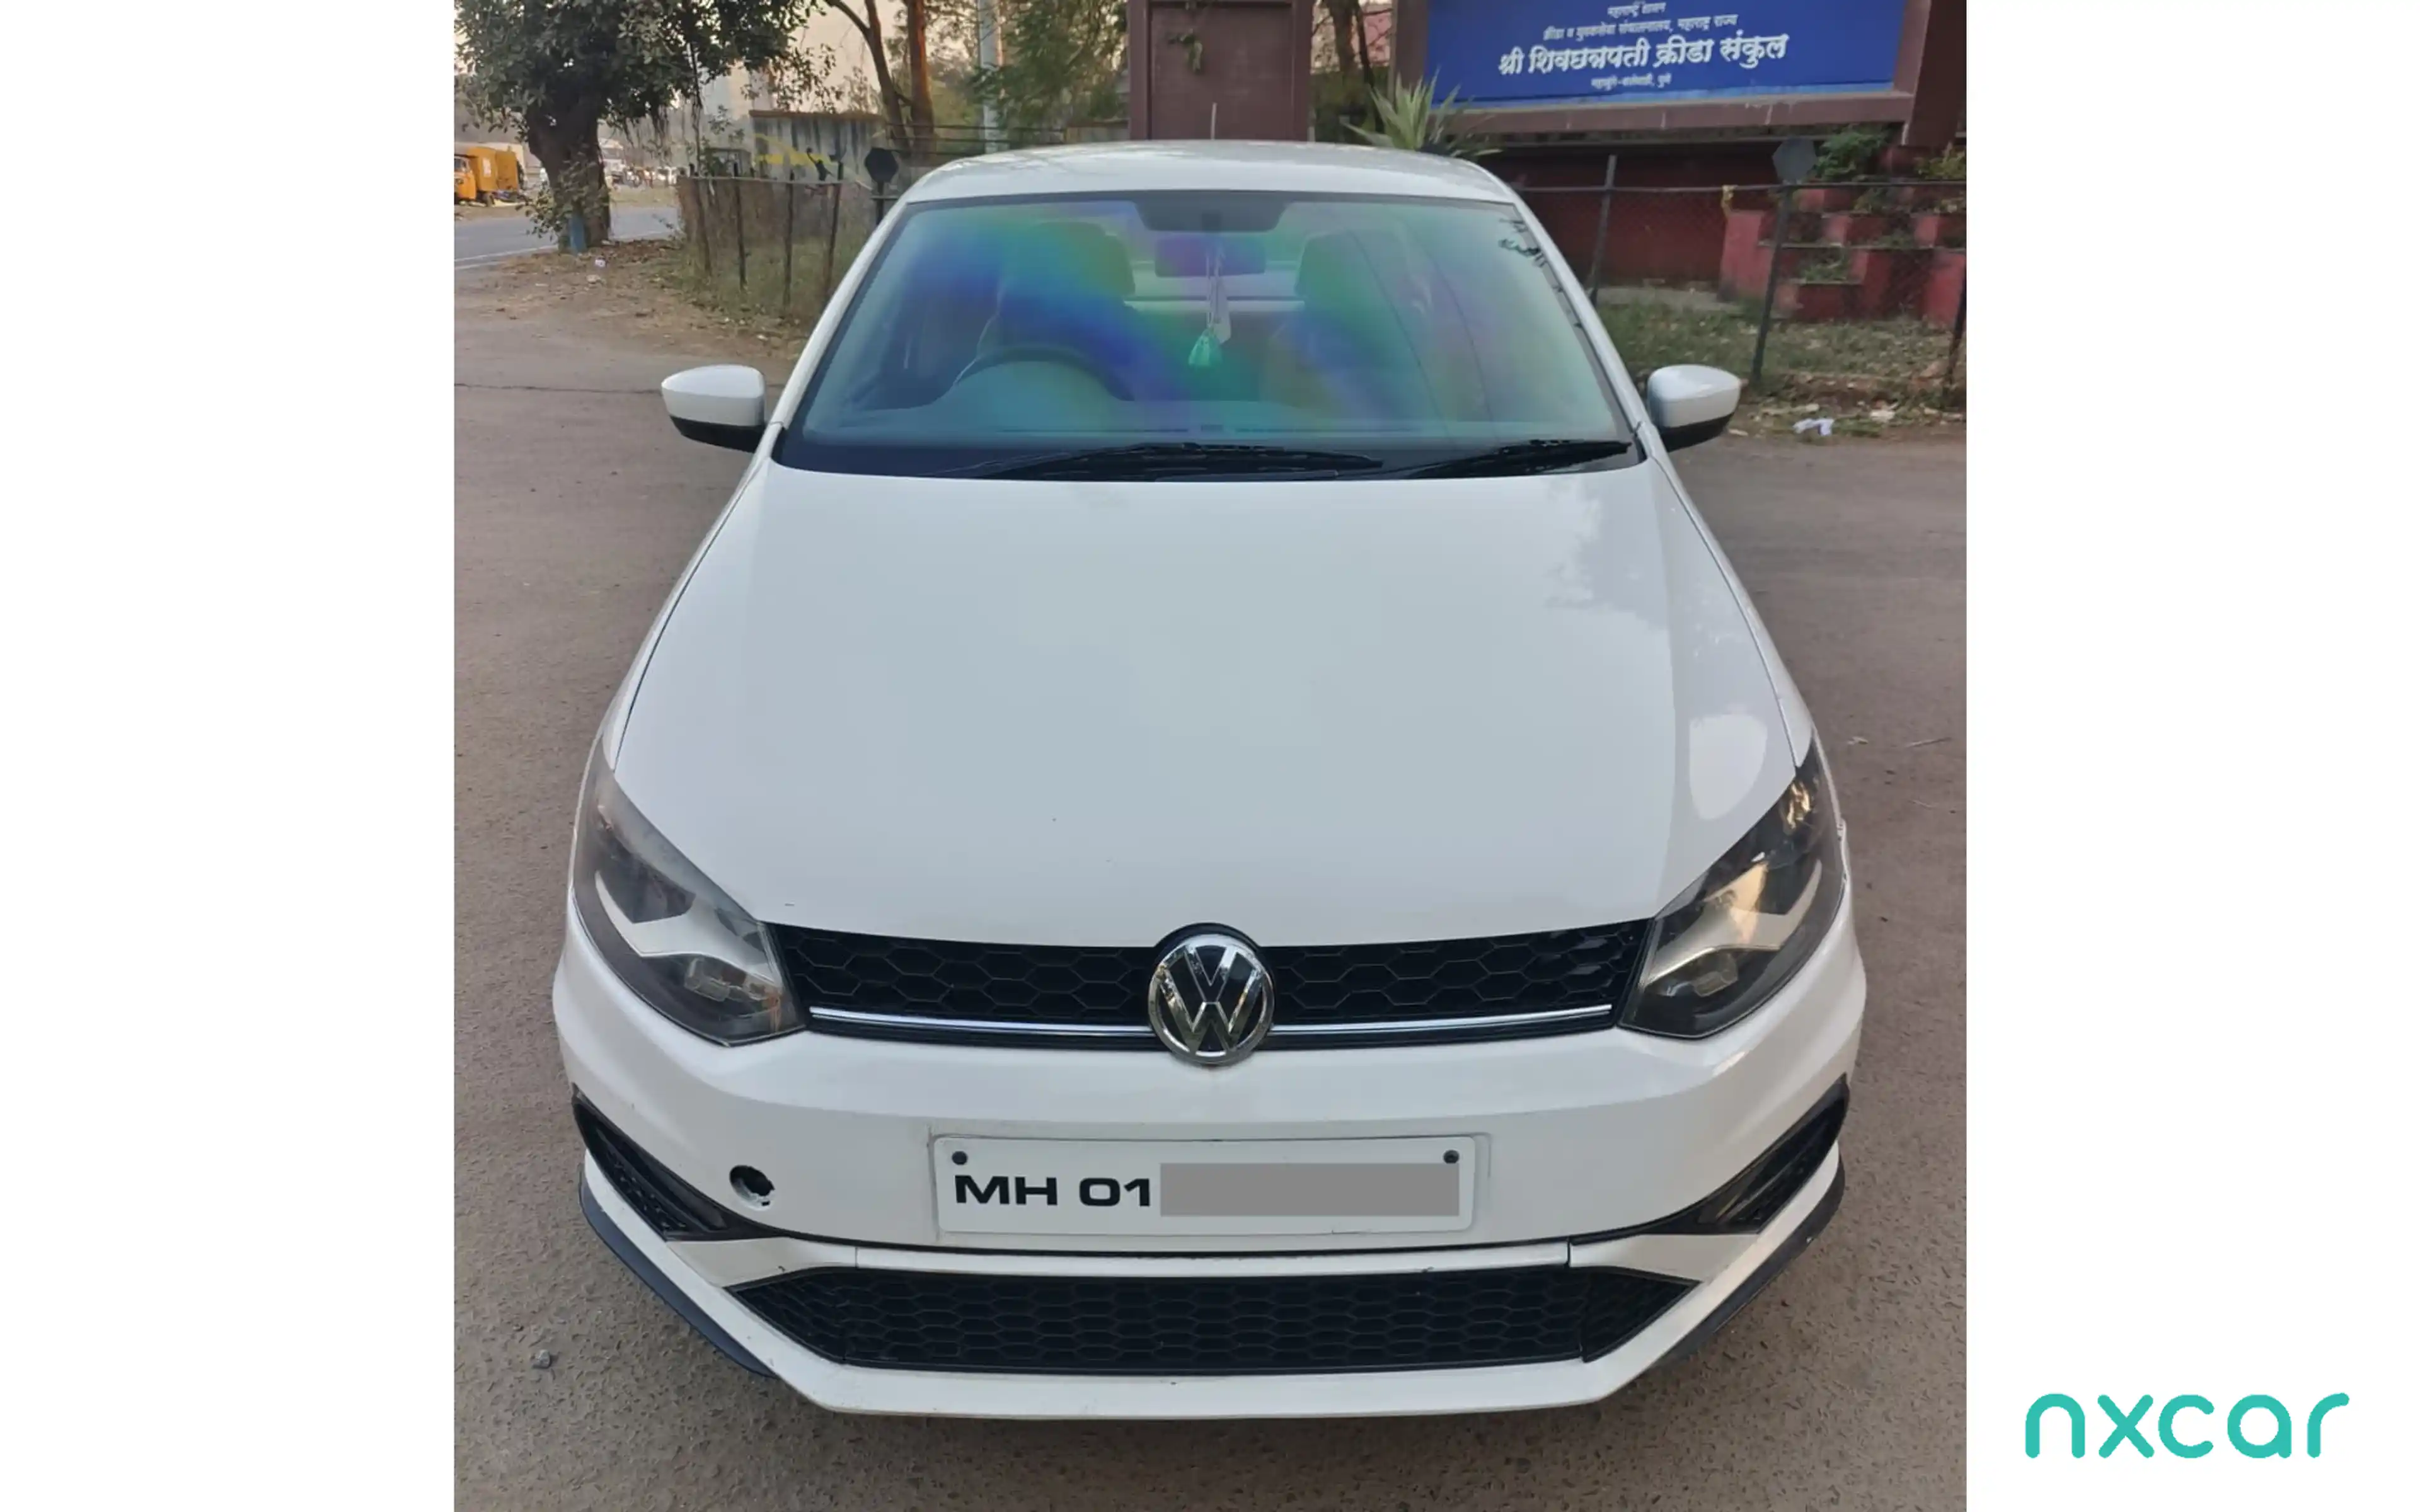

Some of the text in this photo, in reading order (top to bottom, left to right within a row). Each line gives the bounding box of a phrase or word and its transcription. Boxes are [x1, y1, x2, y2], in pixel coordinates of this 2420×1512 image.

[1498, 45, 1525, 75] श्री
[1652, 34, 1715, 68] क्रीडा
[1719, 29, 1789, 69] संकुल
[955, 1174, 1151, 1207] MH 01
